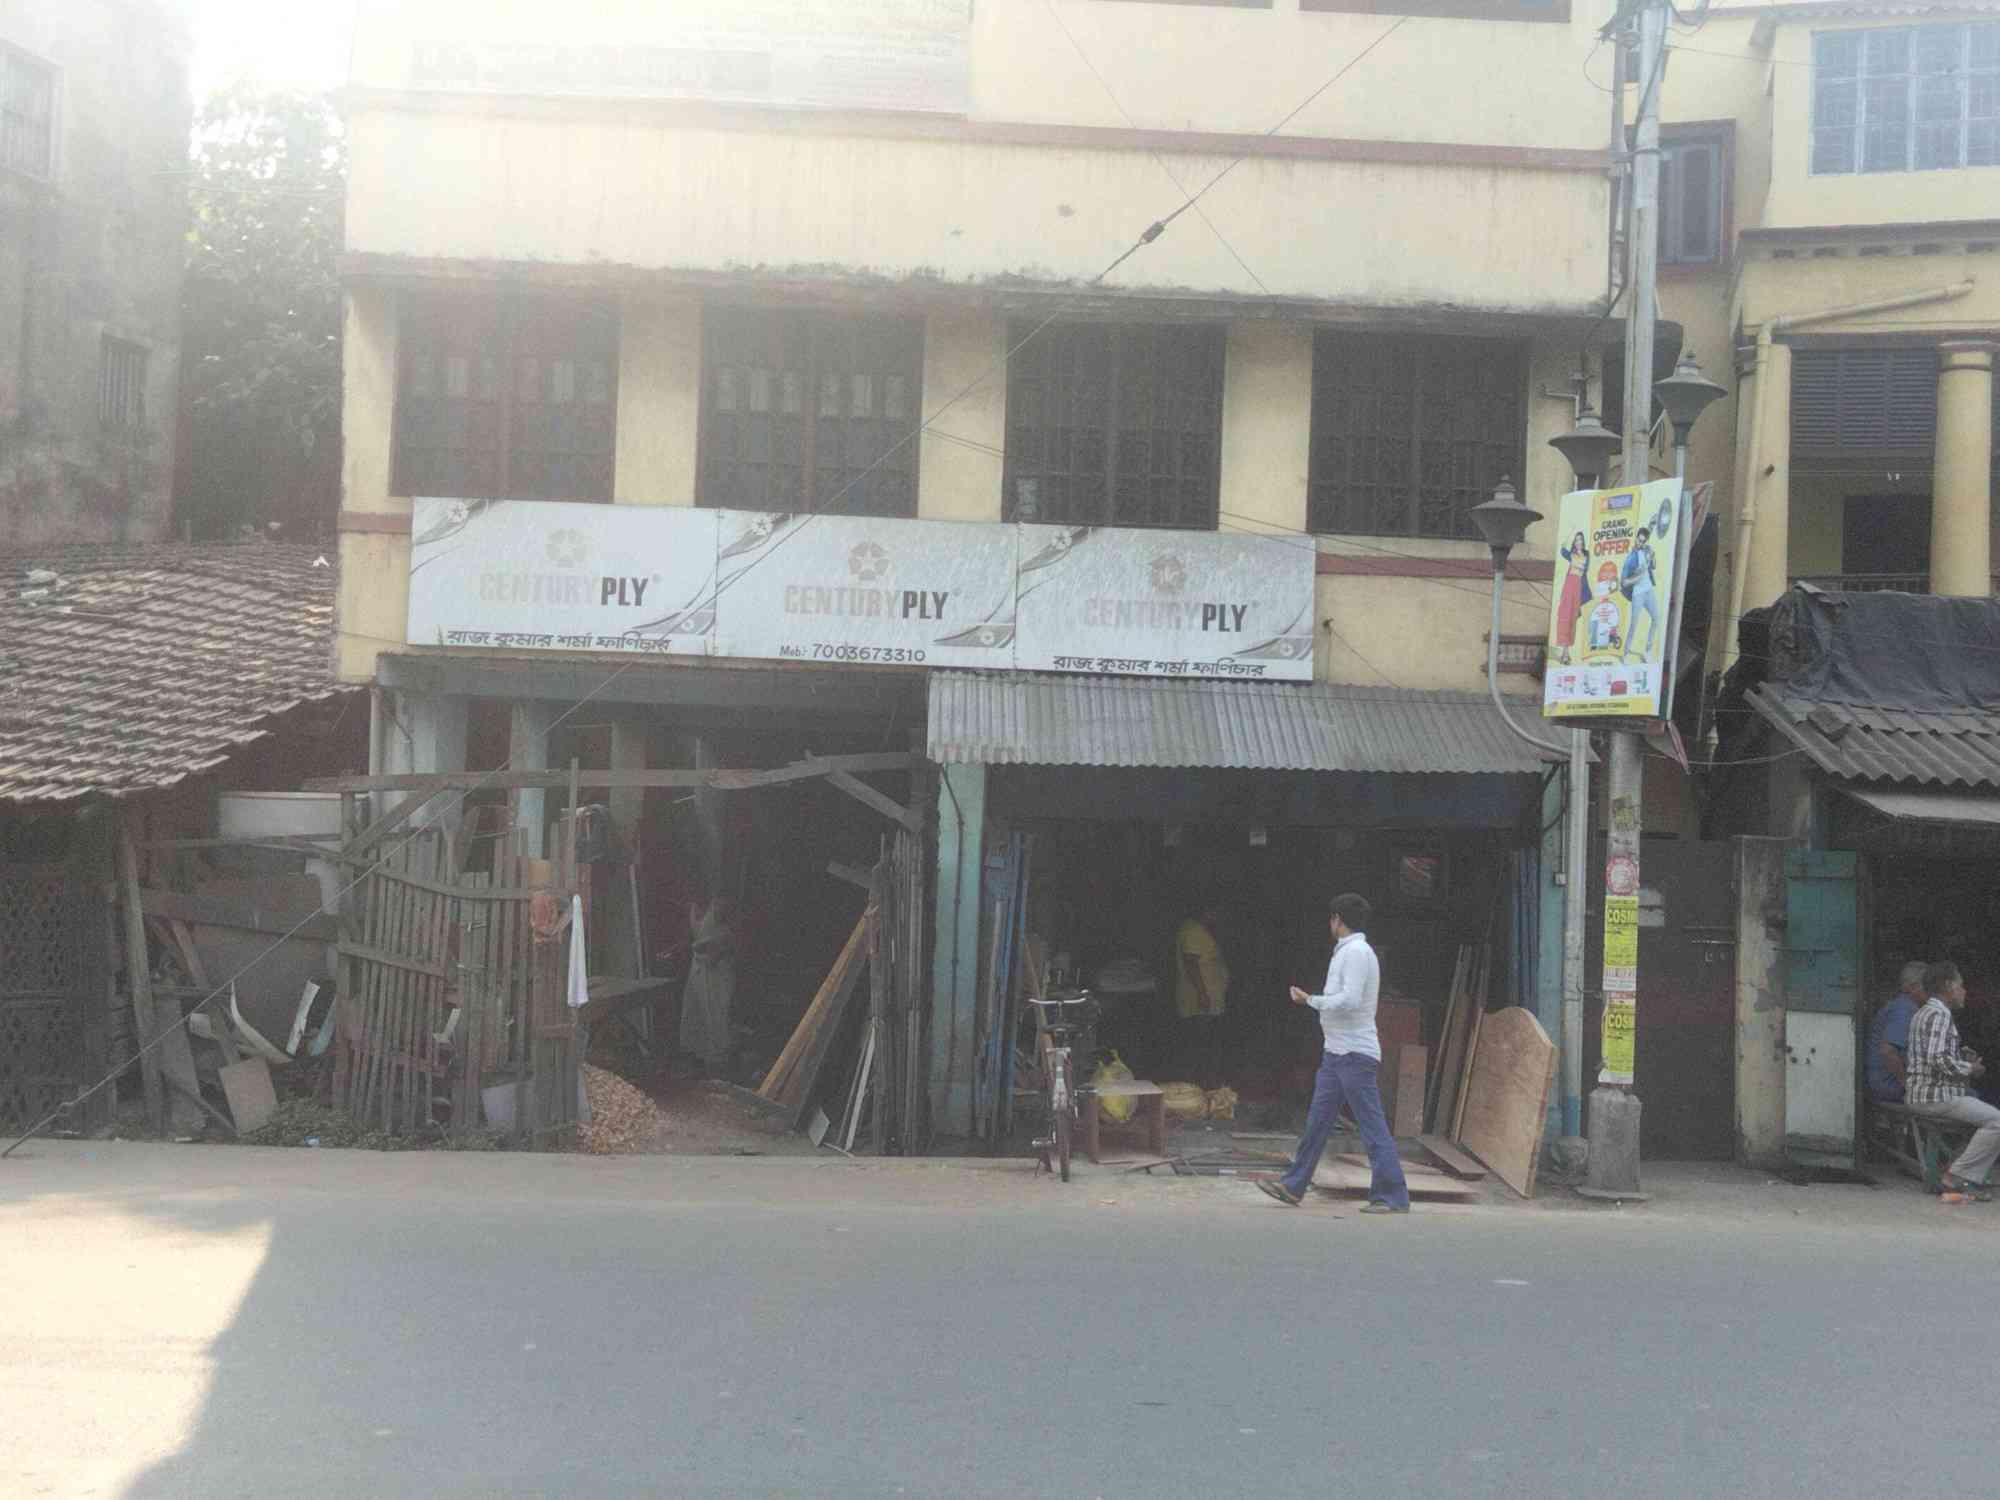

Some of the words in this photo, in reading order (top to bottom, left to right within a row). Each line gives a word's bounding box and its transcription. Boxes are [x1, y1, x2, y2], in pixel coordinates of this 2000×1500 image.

[1602, 518, 1627, 529] GRAND
[1593, 527, 1633, 542] OPENING
[1594, 539, 1631, 556] OFFER
[494, 632, 553, 648] কুমার
[556, 631, 592, 648] শর্মা
[812, 642, 927, 662] 7003673310
[1053, 655, 1094, 671] রাজ
[1096, 657, 1152, 673] কুমার
[1154, 658, 1190, 674] শর্মা
